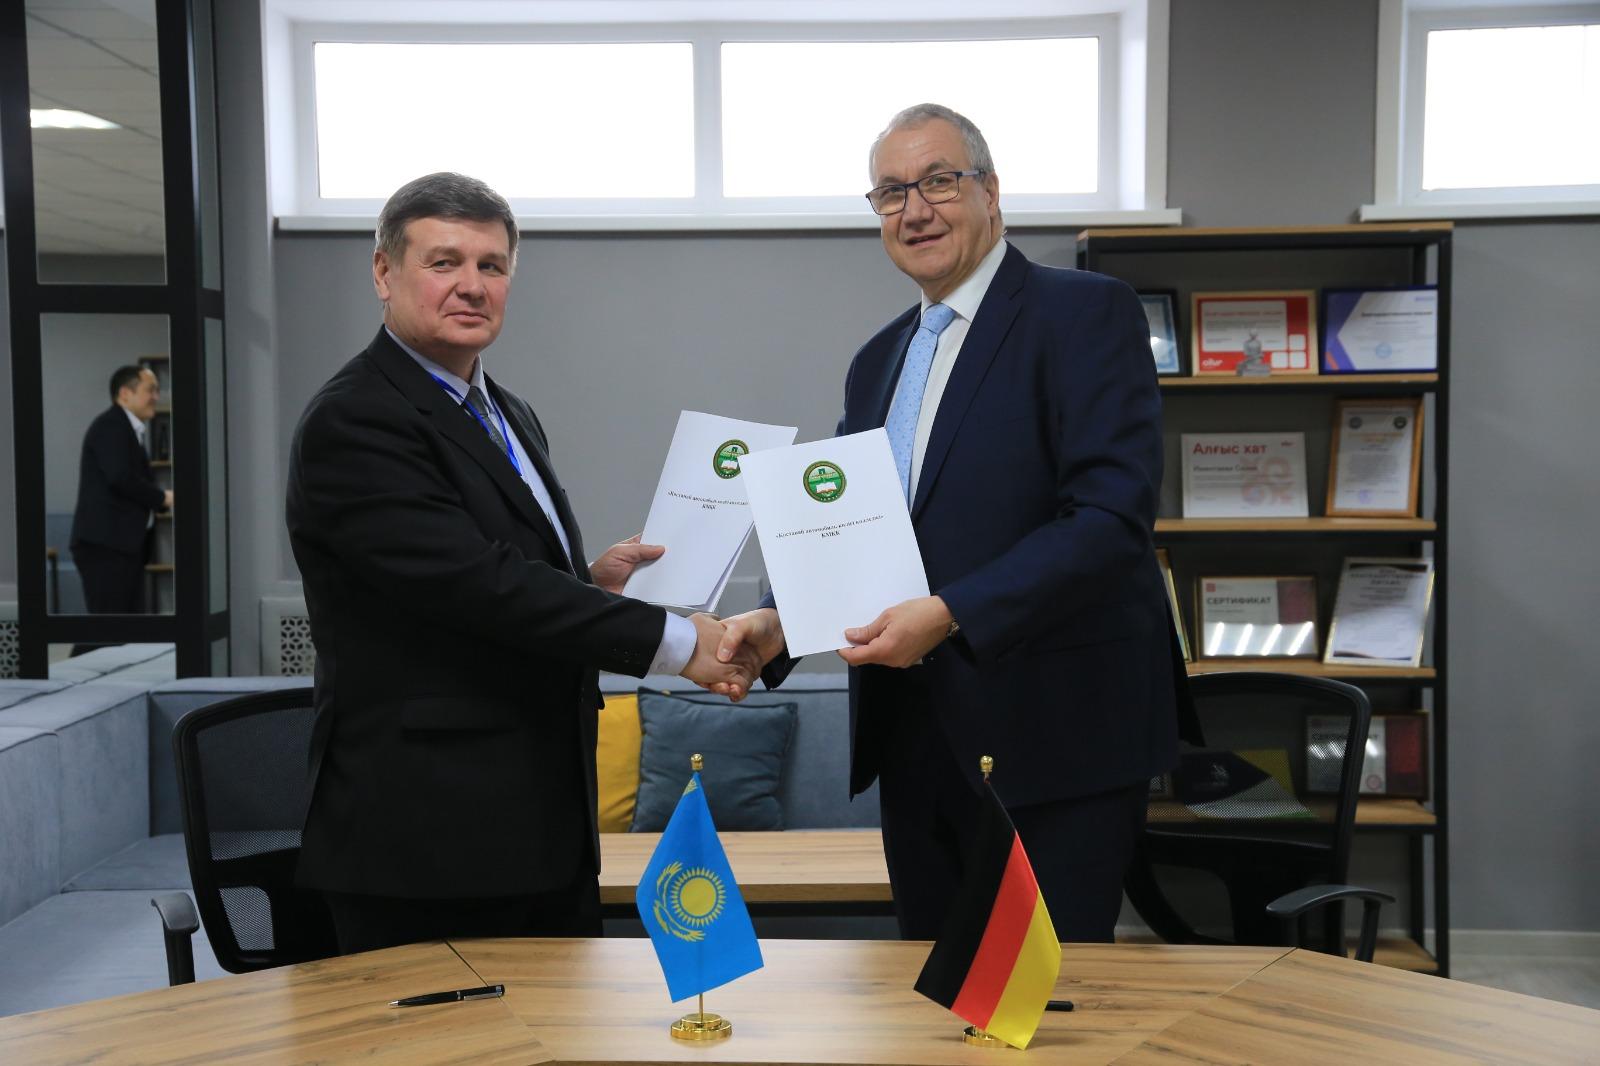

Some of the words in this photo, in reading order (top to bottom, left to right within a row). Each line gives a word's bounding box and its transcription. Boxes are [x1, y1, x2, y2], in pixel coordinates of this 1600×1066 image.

[1193, 442, 1239, 455] Алғыс
[1243, 444, 1267, 455] хат
[1207, 596, 1271, 605] СЕРТИФИКАТ
